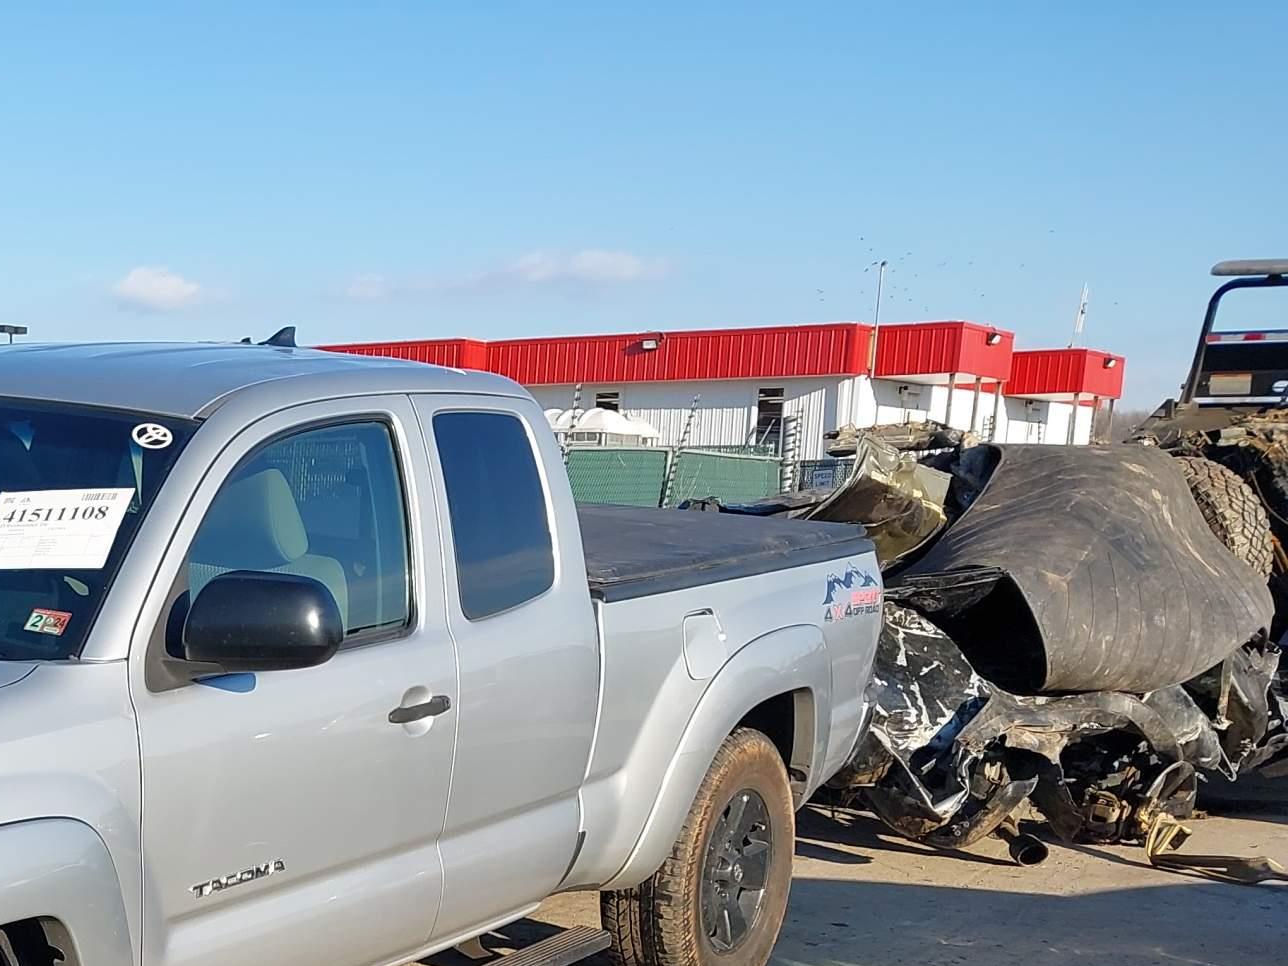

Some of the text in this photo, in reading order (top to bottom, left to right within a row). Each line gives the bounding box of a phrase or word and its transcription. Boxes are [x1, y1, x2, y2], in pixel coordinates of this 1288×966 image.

[2, 506, 109, 523] 41511108
[30, 614, 44, 628] 2
[192, 860, 286, 899] TACOMA
